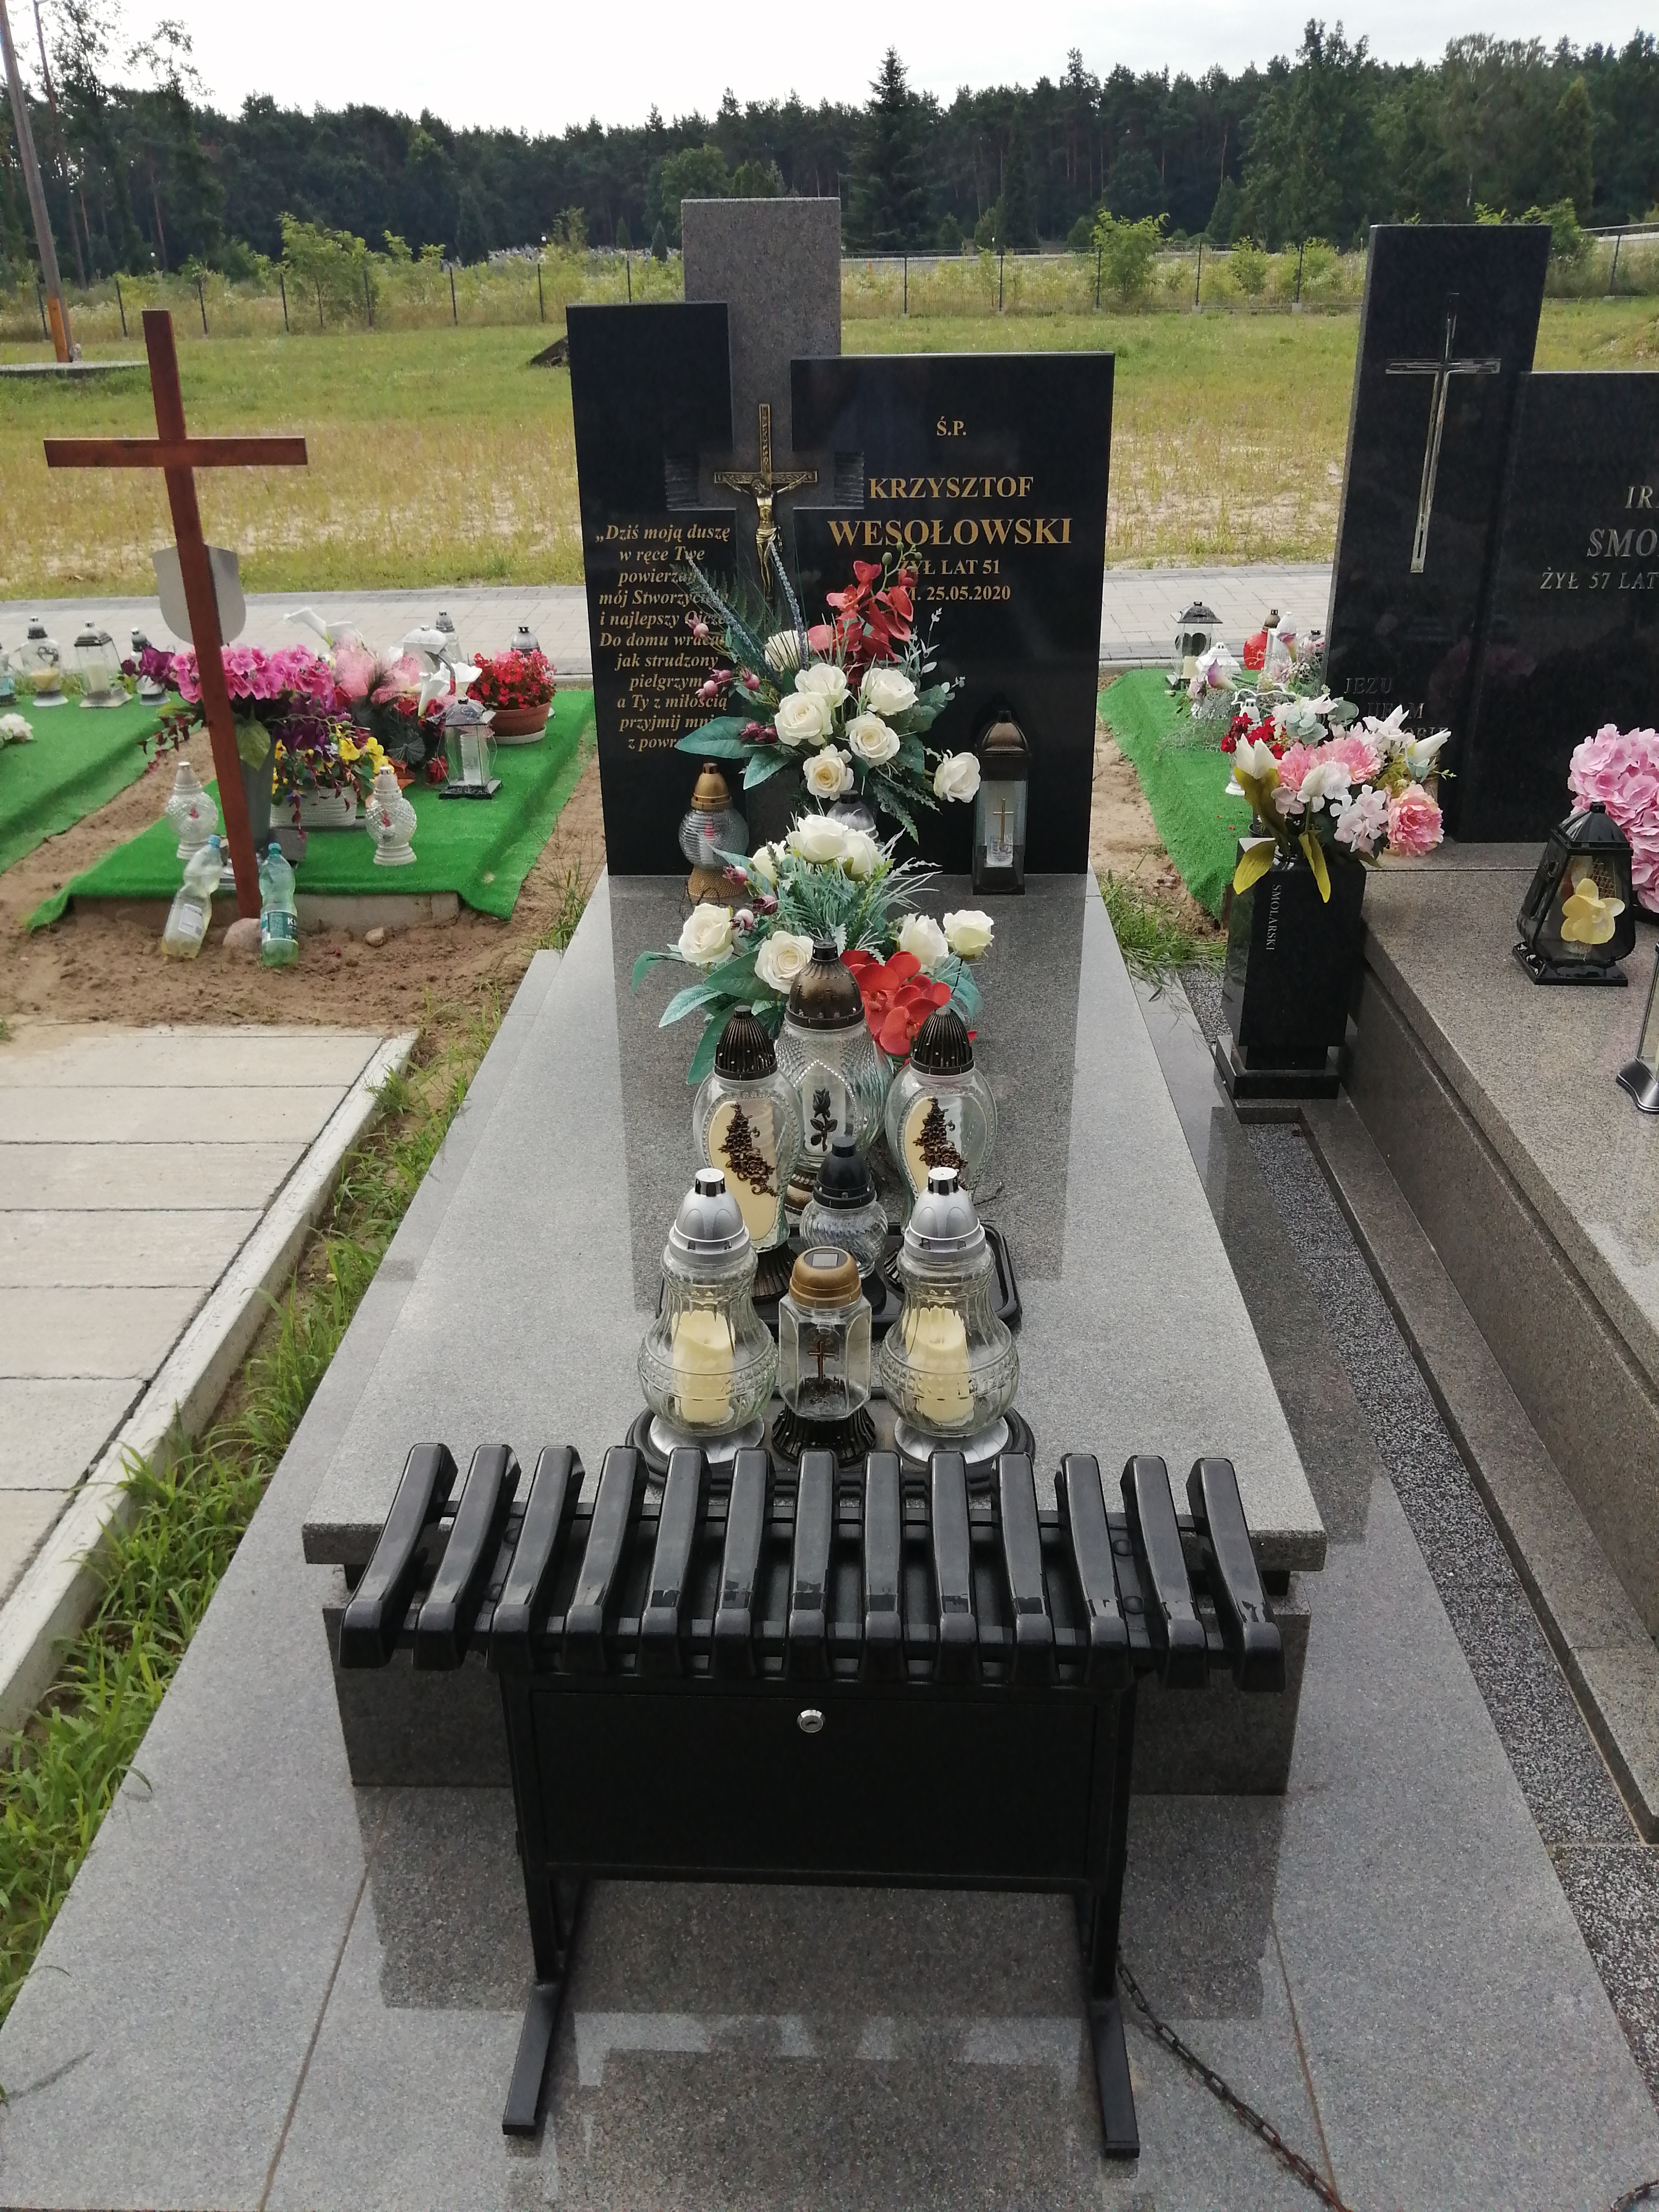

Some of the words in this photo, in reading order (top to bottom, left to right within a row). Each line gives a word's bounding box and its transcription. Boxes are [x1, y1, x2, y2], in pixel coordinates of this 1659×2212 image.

[936, 416, 967, 436] Ś.P.
[869, 476, 1034, 499] KRZYSZTOF
[1624, 485, 1658, 509] IR
[644, 524, 682, 542] moją
[687, 524, 730, 542] duszę
[827, 518, 1073, 546] WESOŁOWSKI
[1587, 529, 1658, 557] SMO
[619, 551, 632, 562] w
[636, 550, 668, 564] ręce
[675, 546, 705, 561] Twe
[941, 559, 978, 574] LAT
[983, 559, 1000, 574] 51
[1540, 567, 1579, 589] ŻYŁ
[1588, 572, 1611, 589] 57
[599, 590, 628, 608] mój
[927, 585, 1011, 600] 25.05.2020
[600, 611, 606, 626] i
[610, 611, 680, 629] najlepszy
[599, 633, 622, 647] Do
[626, 633, 668, 647] domu
[615, 653, 640, 671] jak
[645, 652, 718, 669] strudzony
[630, 674, 702, 691] pielgrzym
[1344, 677, 1392, 694] JEZU
[617, 699, 626, 708] a
[632, 694, 649, 711] Ty
[654, 699, 661, 709] z
[1368, 702, 1425, 719] UFM
[619, 714, 681, 732] przyjmij
[629, 739, 635, 749] z
[1266, 884, 1281, 950] SMOLARSKI
